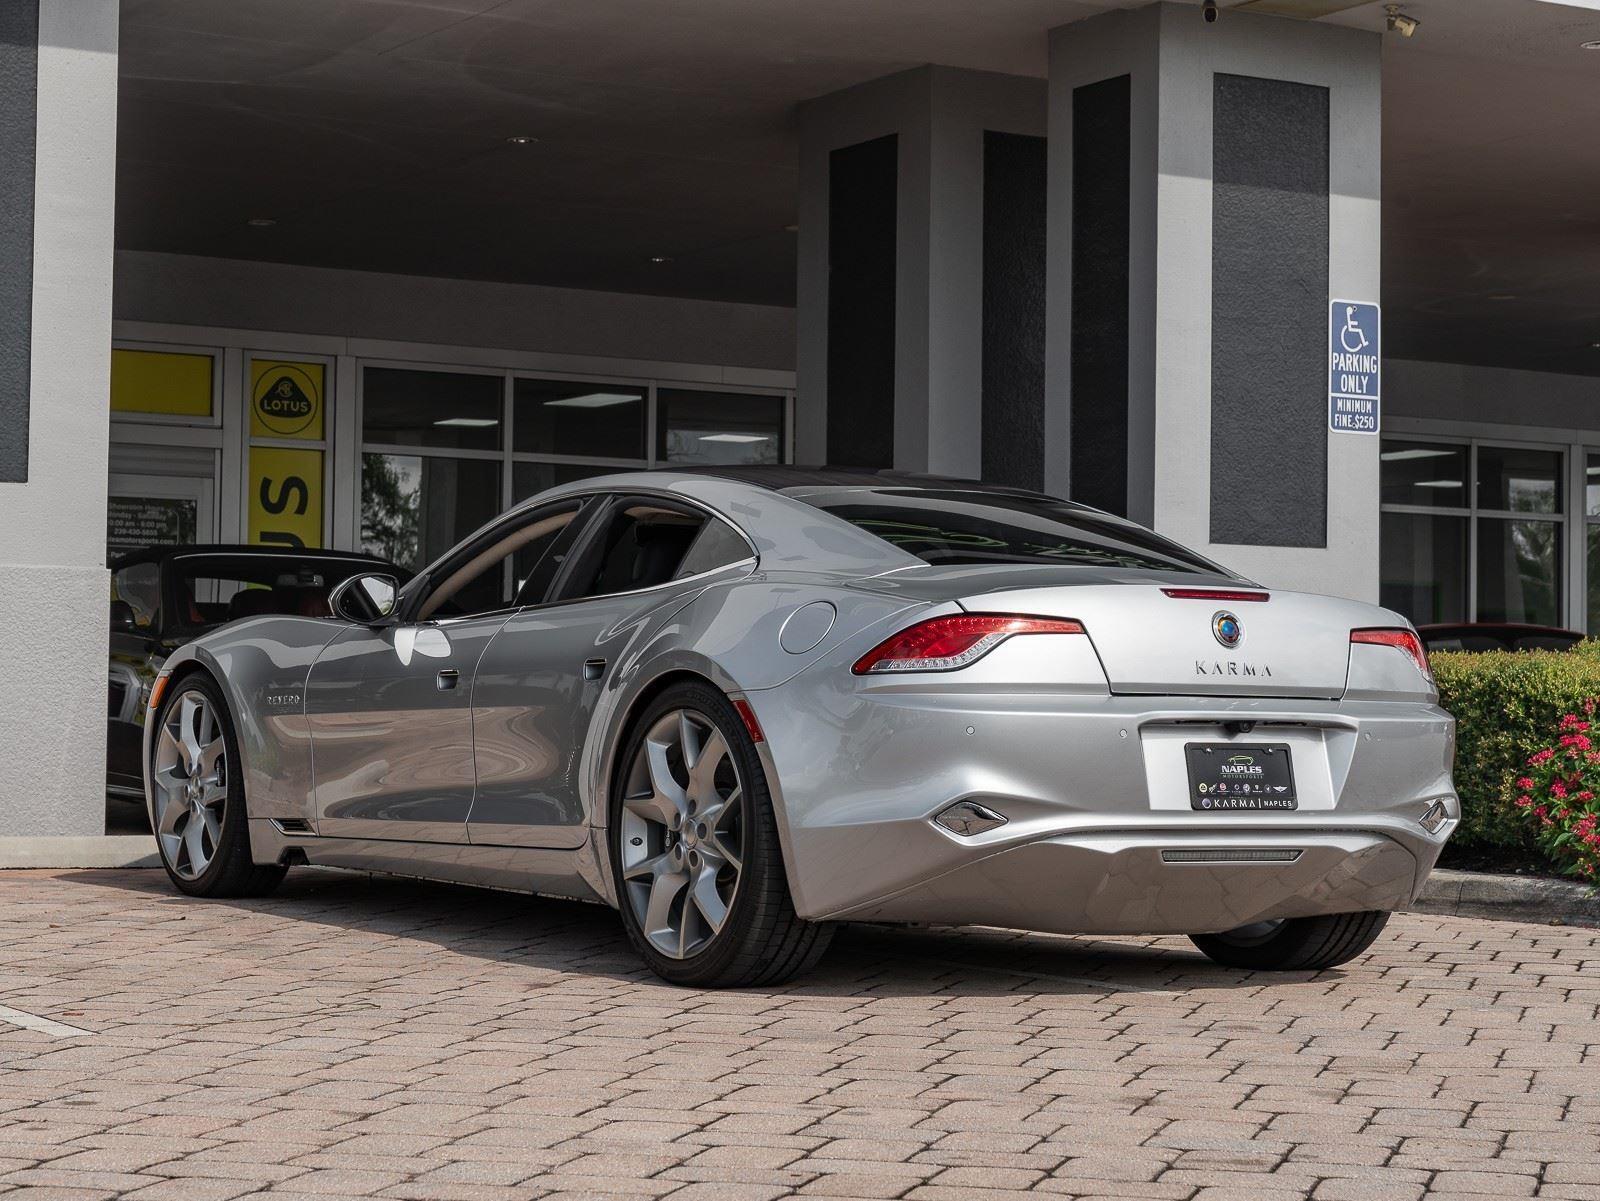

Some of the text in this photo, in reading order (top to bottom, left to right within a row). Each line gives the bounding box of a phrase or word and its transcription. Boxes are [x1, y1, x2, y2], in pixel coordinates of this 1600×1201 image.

[1332, 352, 1377, 374] PARKING
[1340, 374, 1369, 394] ONLY
[263, 399, 309, 413] LOTUS
[1337, 398, 1372, 414] MINIMUM
[1334, 413, 1375, 430] FINE $250
[1195, 660, 1272, 677] KARMA
[266, 695, 300, 705] REVERO
[1221, 765, 1263, 774] NAPLES
[1213, 799, 1293, 809] KARMA NAPLES
